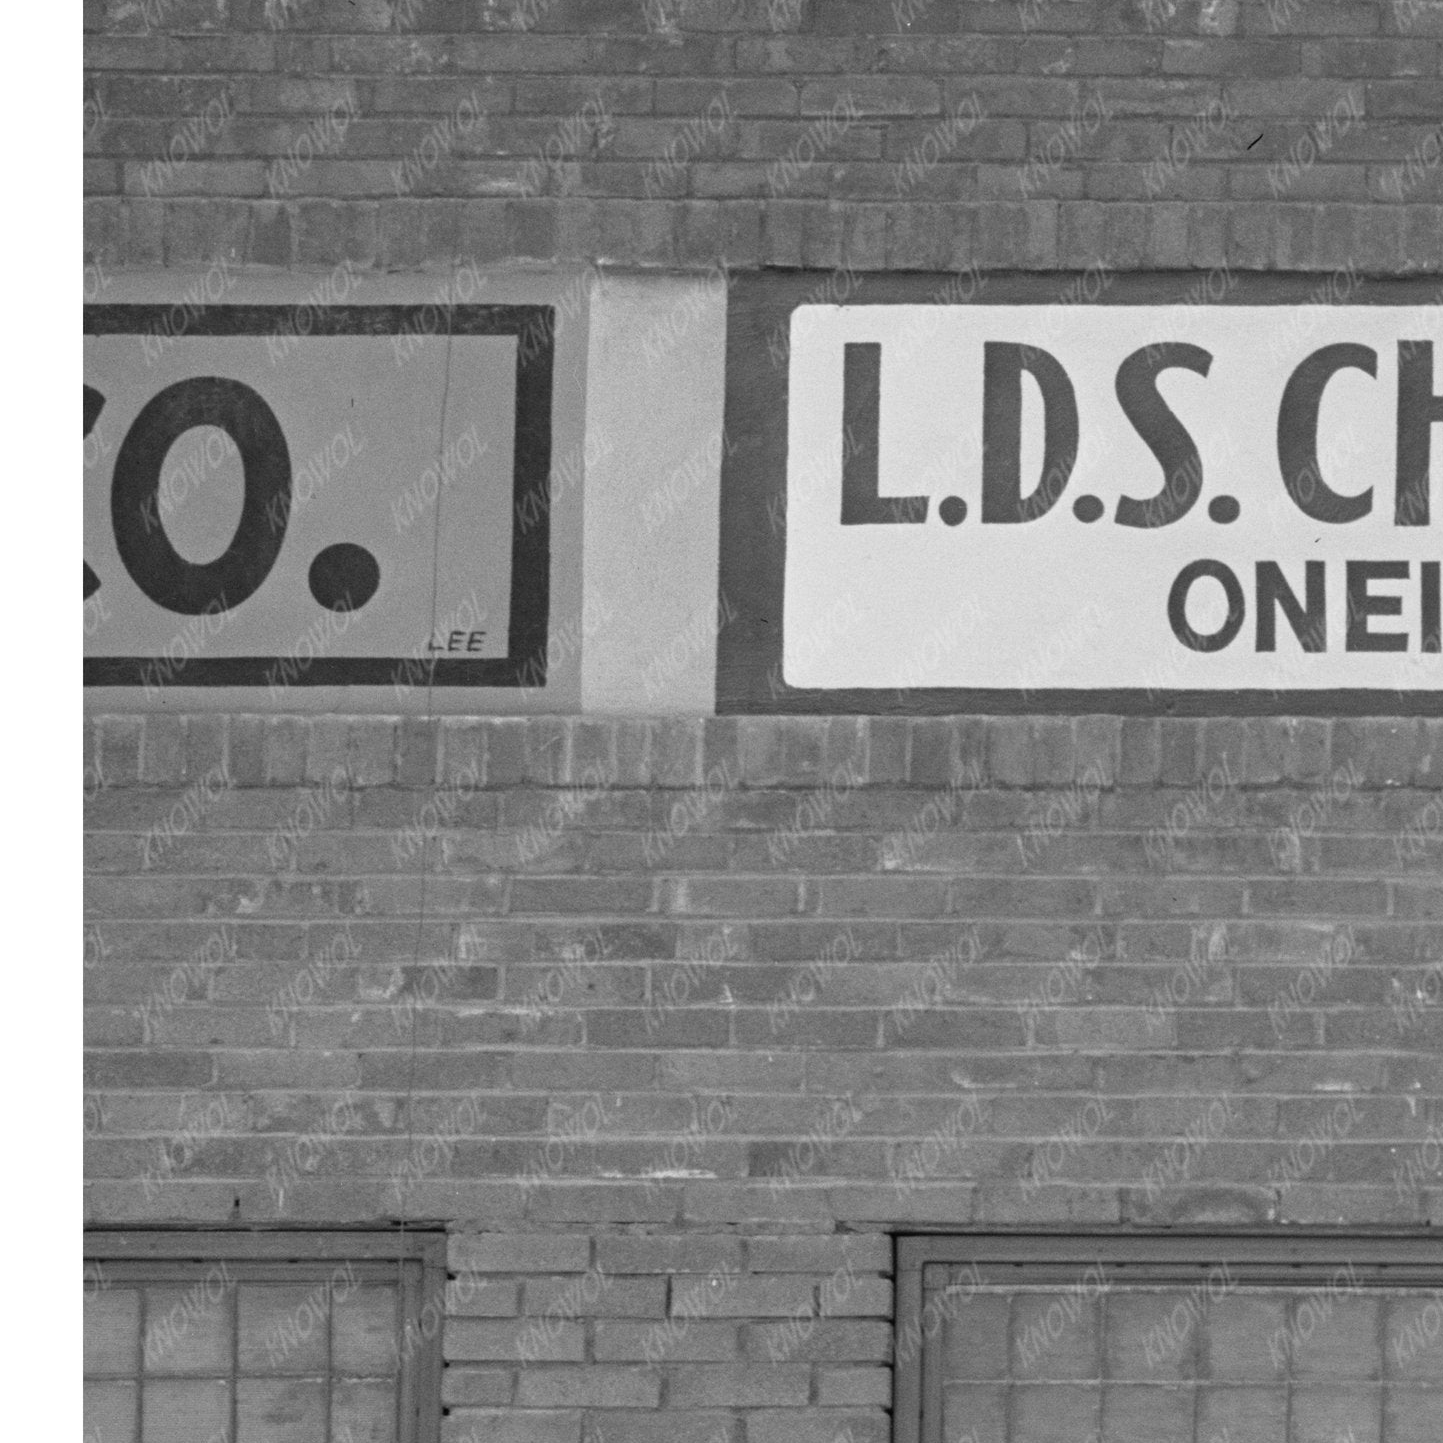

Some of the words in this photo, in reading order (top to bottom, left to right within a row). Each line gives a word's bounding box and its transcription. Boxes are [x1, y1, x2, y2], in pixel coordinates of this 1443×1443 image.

[83, 376, 380, 616] O.
[840, 339, 1240, 530] L.D.S.
[428, 630, 486, 652] LEE
